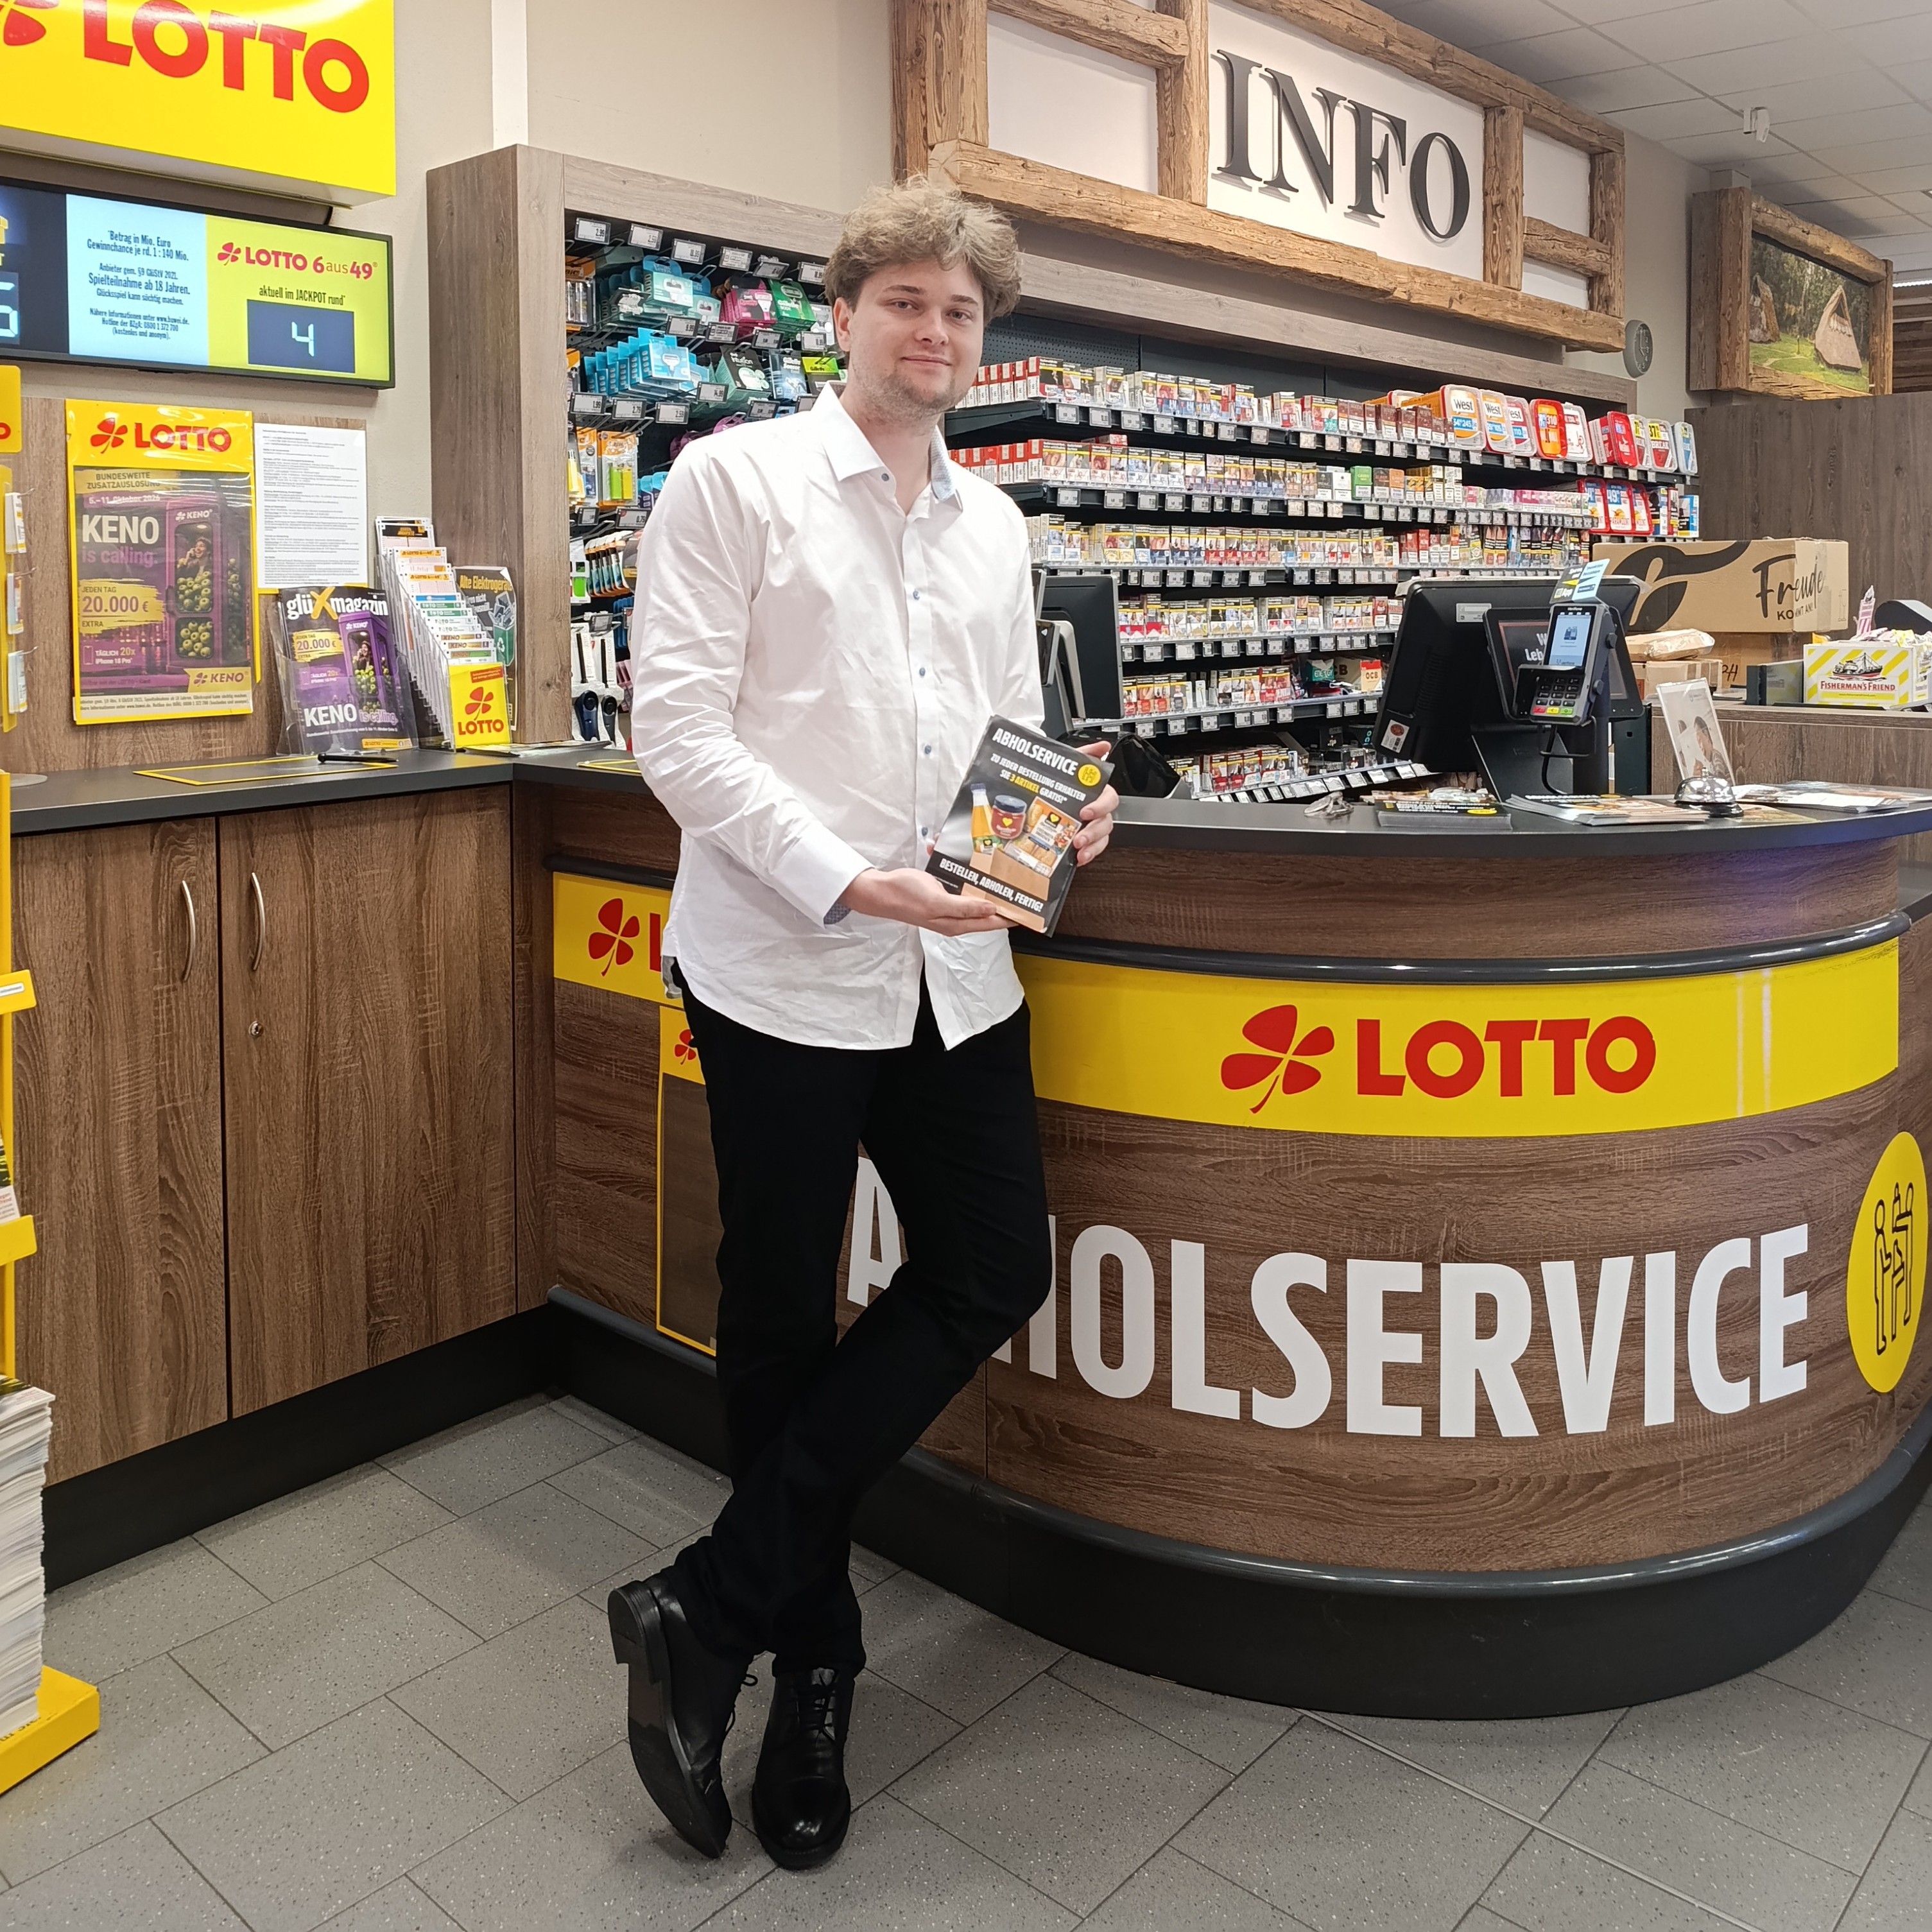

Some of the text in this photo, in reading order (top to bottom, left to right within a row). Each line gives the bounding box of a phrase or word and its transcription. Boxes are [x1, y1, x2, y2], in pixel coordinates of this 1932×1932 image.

[84, 0, 370, 114] LOTTO
[1217, 49, 1470, 239] INFO
[87, 239, 133, 254] Gewinnchance
[134, 245, 141, 255] je
[142, 247, 151, 256] rd.
[162, 248, 173, 259] 140
[175, 250, 189, 261] Mio.
[133, 234, 139, 243] in
[141, 235, 155, 245] Mio.
[157, 237, 171, 247] Euro
[99, 263, 122, 273] Anbieter
[245, 246, 308, 271] LOTTO
[89, 273, 190, 295] Spielteilnahme ab 18 Jahren.
[259, 285, 283, 298] aktuell
[285, 288, 293, 300] im
[295, 289, 327, 304] JACKPOT
[292, 322, 315, 357] 4
[1453, 399, 1474, 411] West
[1485, 402, 1502, 415] West
[1510, 410, 1522, 419] est
[135, 422, 232, 453] LOTTO
[96, 472, 151, 481] BUNDESWEITE
[82, 514, 159, 544] KENO
[82, 546, 159, 567] is calling.
[460, 575, 472, 589] Alte
[1752, 553, 1826, 619] Freude
[82, 596, 148, 613] 20.000 €
[120, 647, 136, 656] 20x
[297, 639, 330, 650] 20.000
[1868, 682, 1896, 691] FRIEND
[304, 703, 358, 727] KENO
[458, 719, 505, 736] LOTTO
[992, 728, 1079, 775] ABHOLSERVICE
[990, 754, 1086, 802] ZU JEDER BESTELLUNG ERHALTEN
[1000, 770, 1012, 780] SIE
[1015, 777, 1040, 793] ARTIKEL
[940, 858, 979, 885] BESTELLEN,
[979, 877, 1014, 901] ABHOLEN,
[1015, 892, 1044, 912] FERTIG!
[1356, 1016, 1657, 1098] LOTTO
[847, 1158, 1809, 1438] AHOLSERVICE
